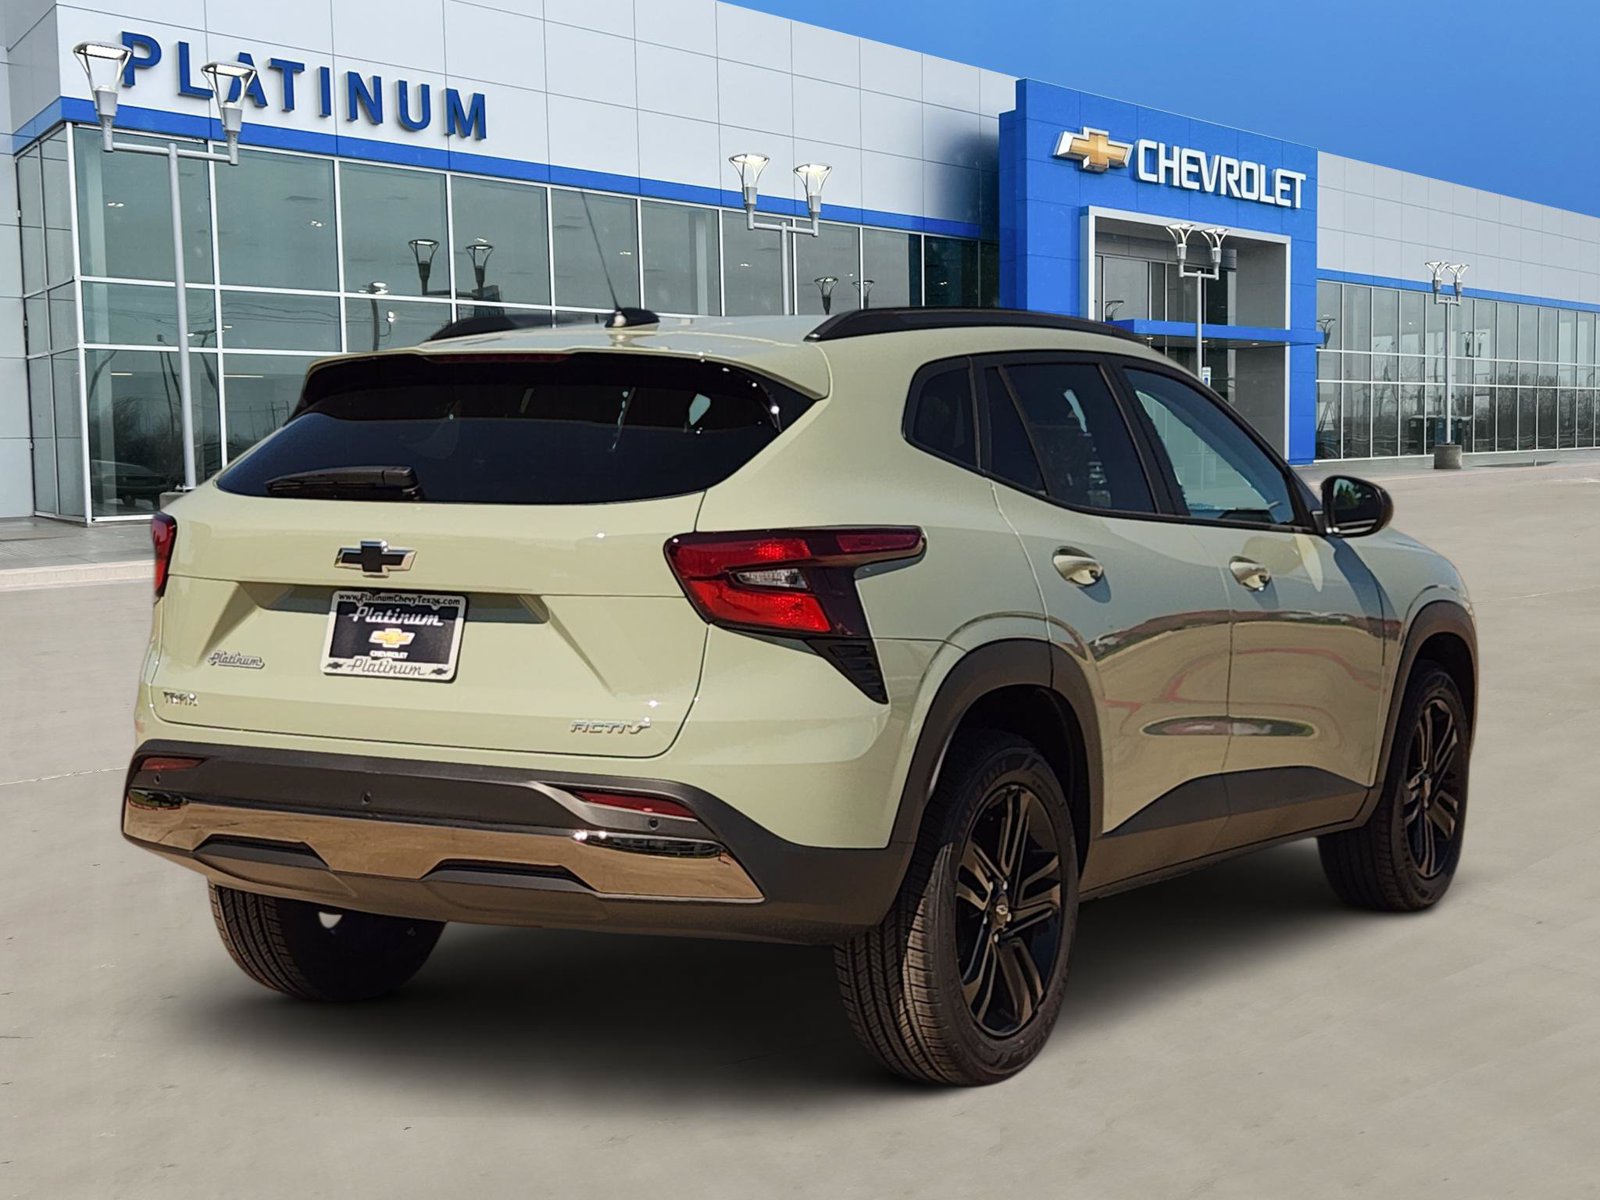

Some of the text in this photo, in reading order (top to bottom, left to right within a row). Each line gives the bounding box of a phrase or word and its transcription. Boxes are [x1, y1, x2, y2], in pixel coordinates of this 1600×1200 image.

[120, 31, 487, 140] PLATINUM
[1136, 139, 1306, 208] CHEVROLET
[348, 607, 444, 626] Platinum
[208, 651, 265, 669] Platinum
[347, 657, 427, 676] Platinum
[570, 720, 651, 735] ACTIV
